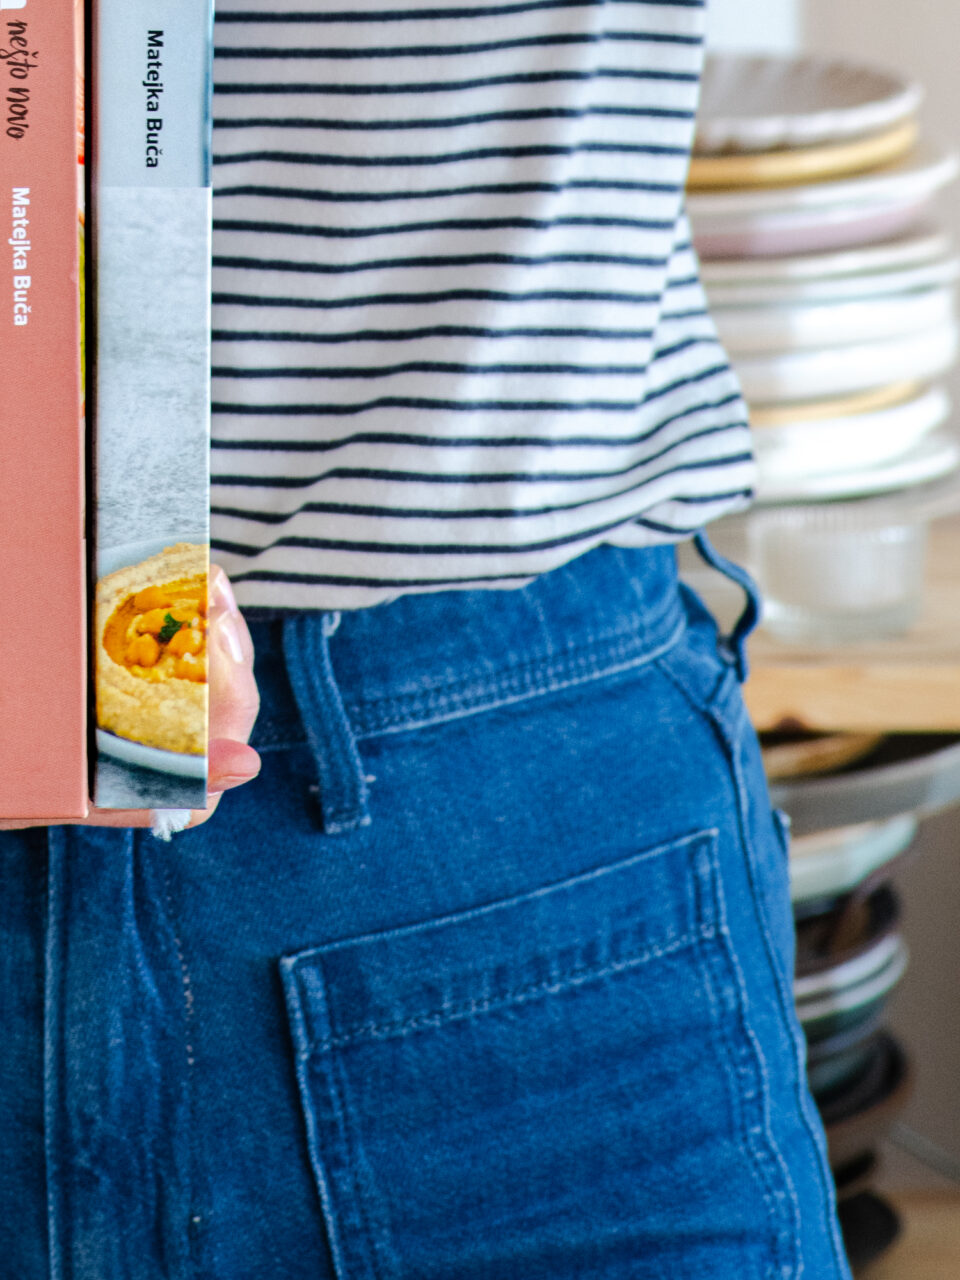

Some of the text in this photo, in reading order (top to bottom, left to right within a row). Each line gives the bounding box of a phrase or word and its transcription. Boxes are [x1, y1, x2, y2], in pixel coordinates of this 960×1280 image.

[5, 87, 31, 140] novo
[141, 29, 165, 169] Matejka Buča
[7, 186, 32, 326] Matejka Buča
